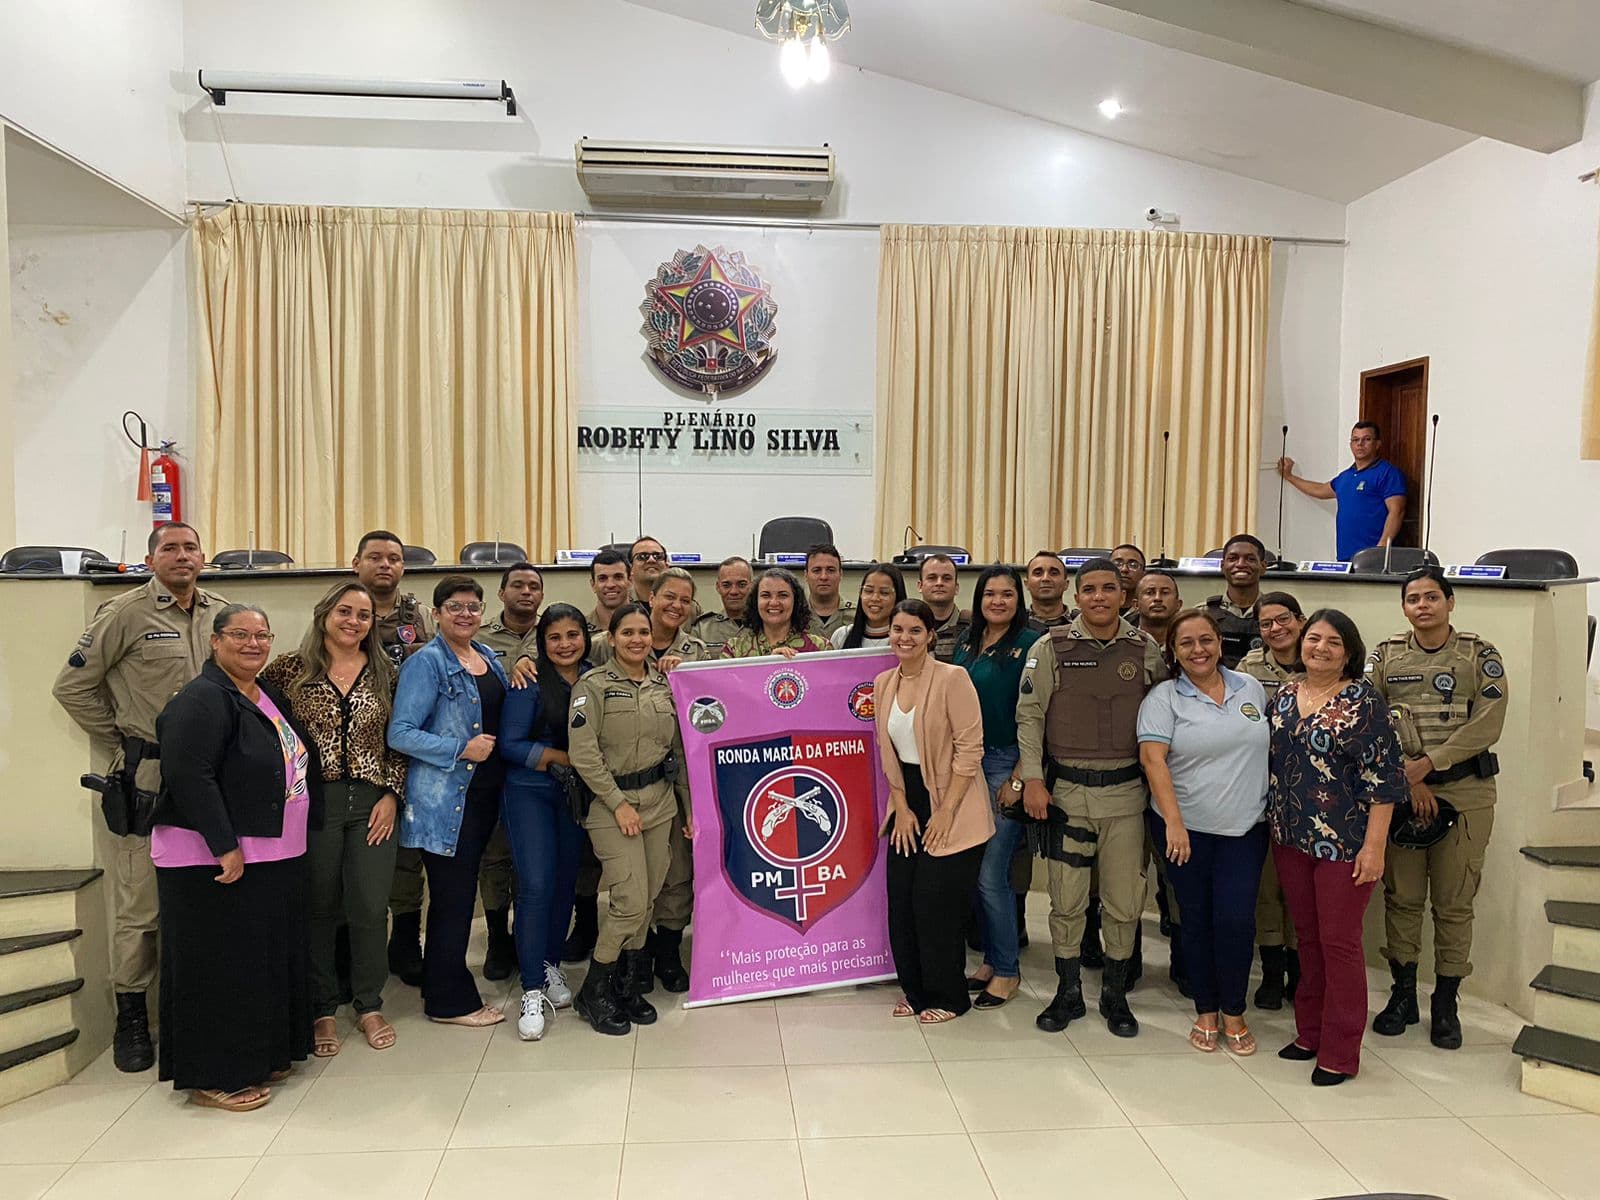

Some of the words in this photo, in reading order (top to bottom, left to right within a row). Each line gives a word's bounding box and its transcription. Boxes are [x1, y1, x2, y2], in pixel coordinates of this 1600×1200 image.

[664, 409, 757, 427] PLENÁRIO
[577, 426, 682, 450] ROBETY
[693, 428, 756, 451] LINO
[767, 429, 841, 451] SILVA
[860, 704, 875, 715] 55
[717, 748, 761, 765] RONDA
[763, 745, 803, 762] MARIA
[806, 743, 823, 759] DA
[825, 739, 865, 757] PENHA
[751, 870, 782, 888] PM
[818, 864, 847, 881] BA
[765, 943, 818, 964] proteção
[822, 941, 849, 957] para
[852, 938, 866, 950] as
[712, 969, 769, 988] mulheres
[772, 968, 796, 982] que
[800, 960, 828, 976] mais
